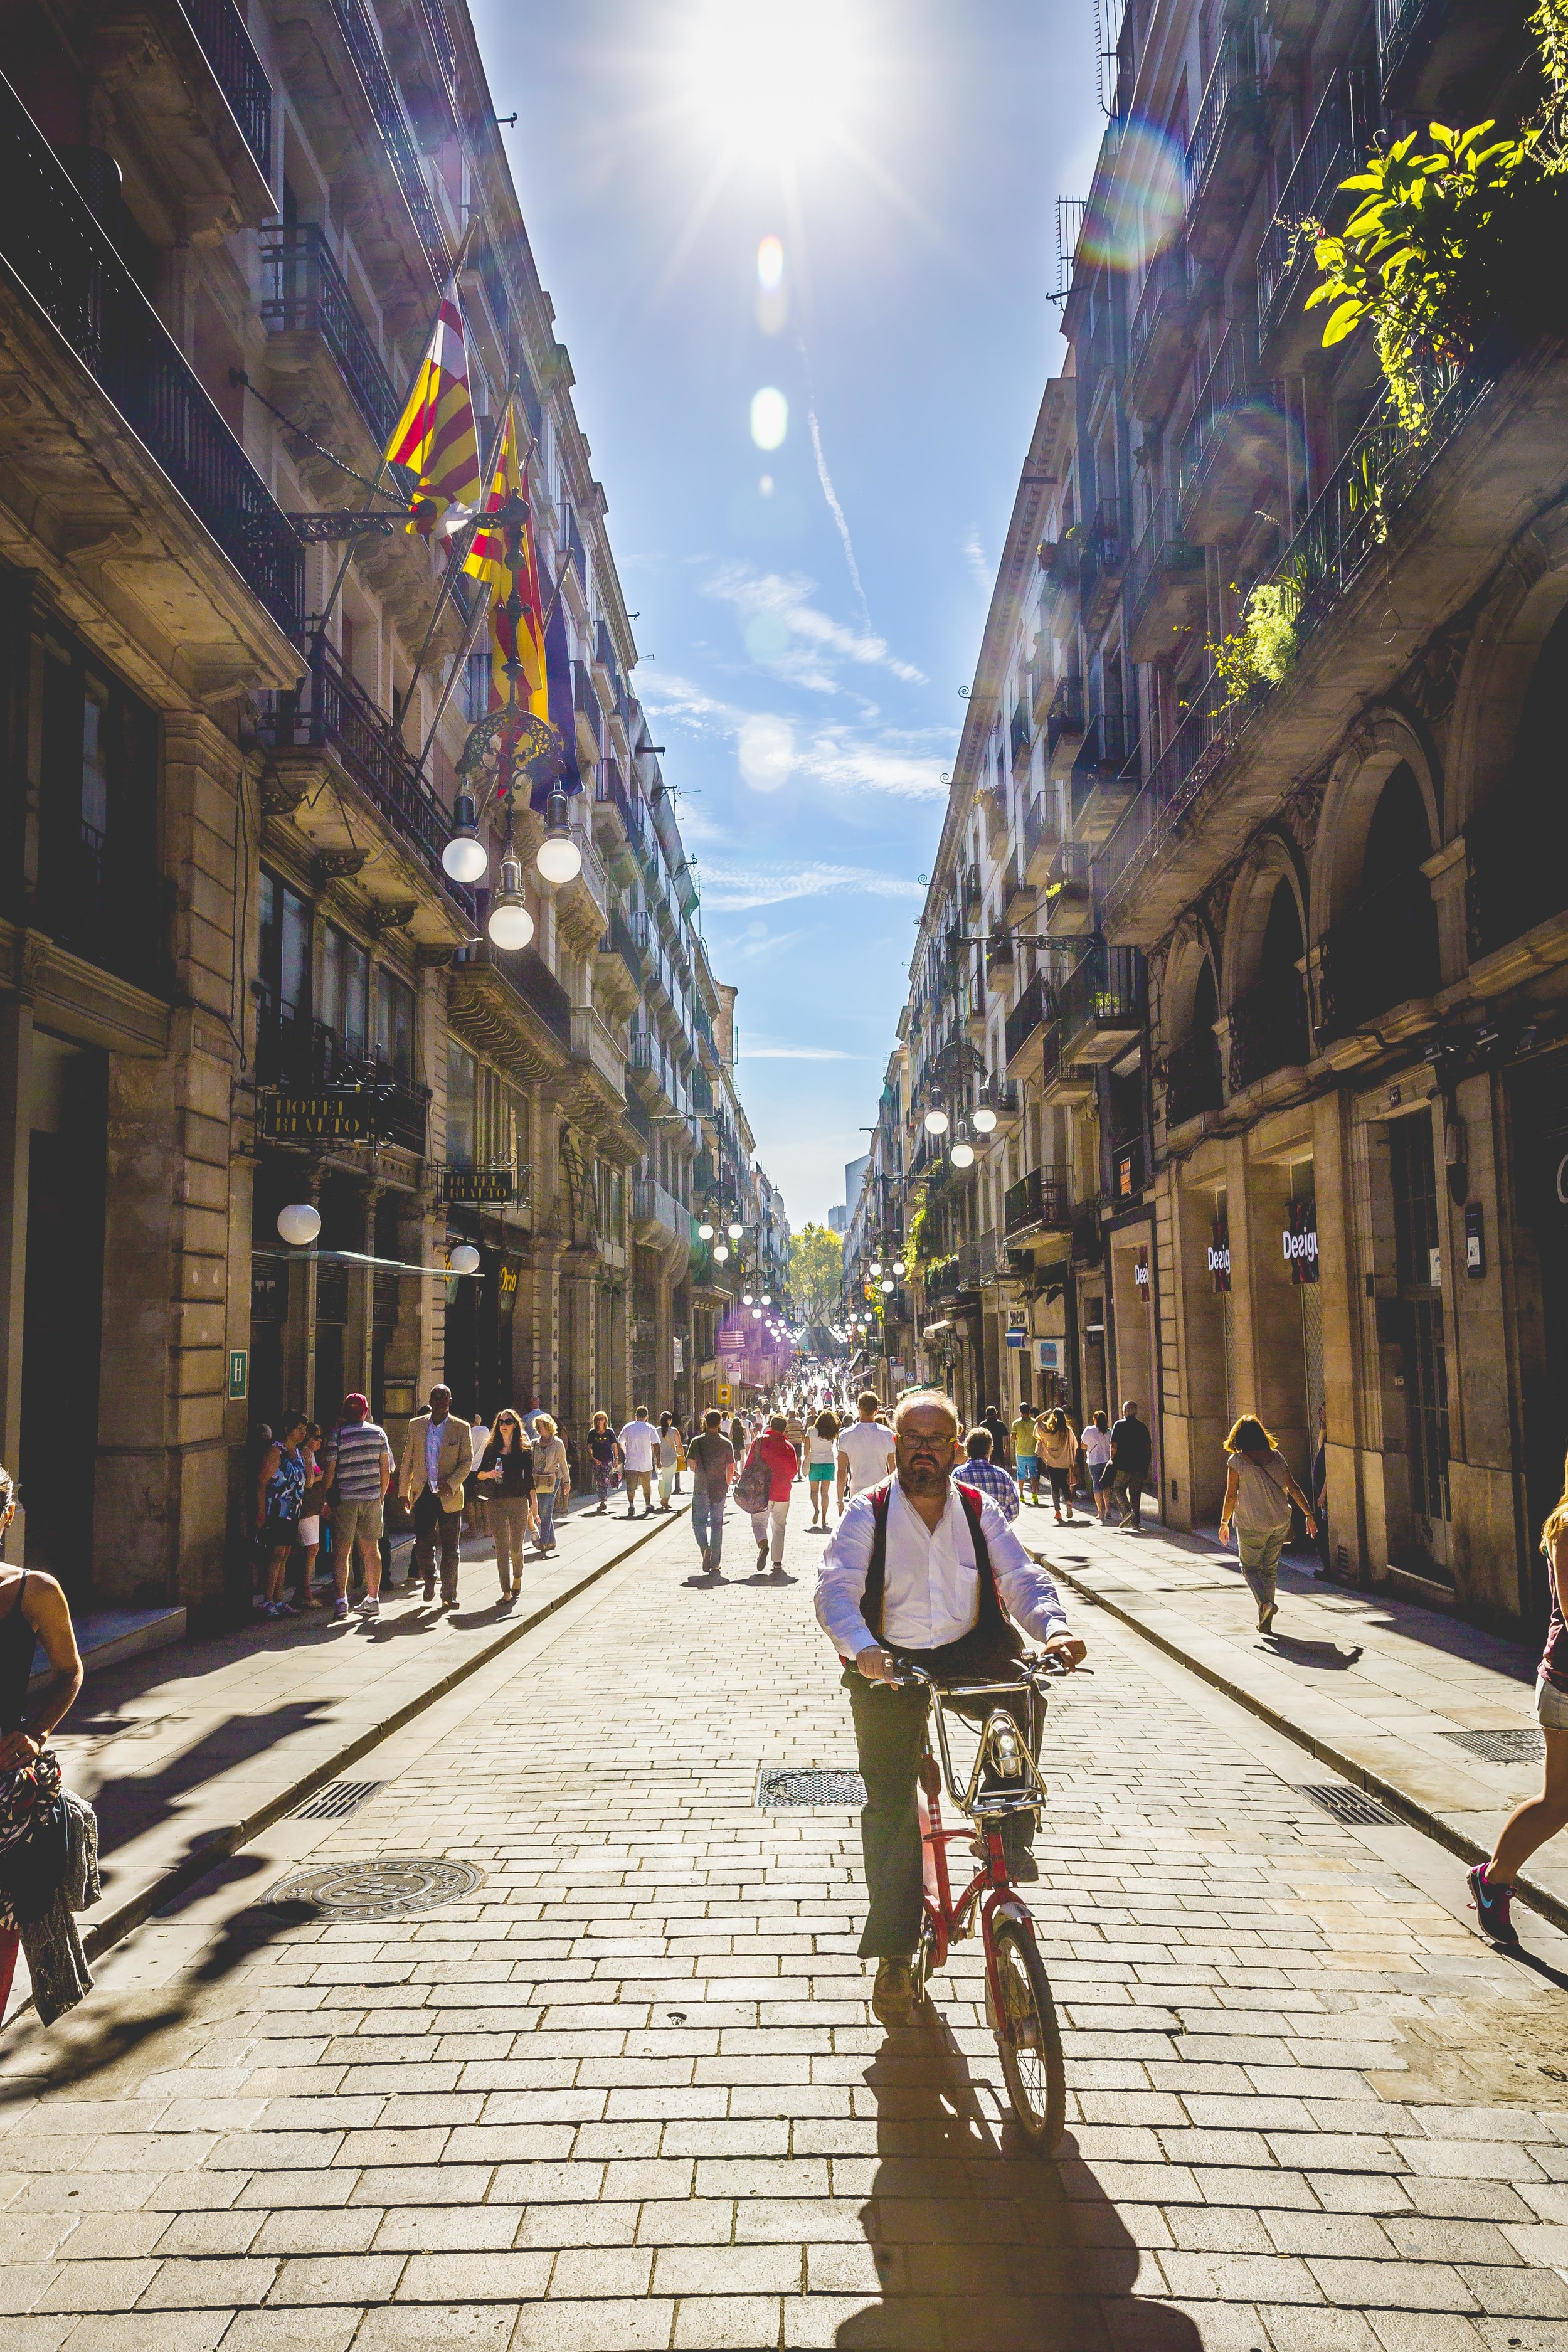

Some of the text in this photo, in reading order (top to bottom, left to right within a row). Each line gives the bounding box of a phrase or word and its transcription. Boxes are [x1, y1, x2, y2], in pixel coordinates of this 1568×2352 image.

[277, 1099, 351, 1115] HOTEL
[276, 1117, 359, 1133] RIALTO
[450, 1175, 501, 1187] HOTEL
[450, 1187, 506, 1199] RIALTO
[233, 1357, 243, 1382] H
